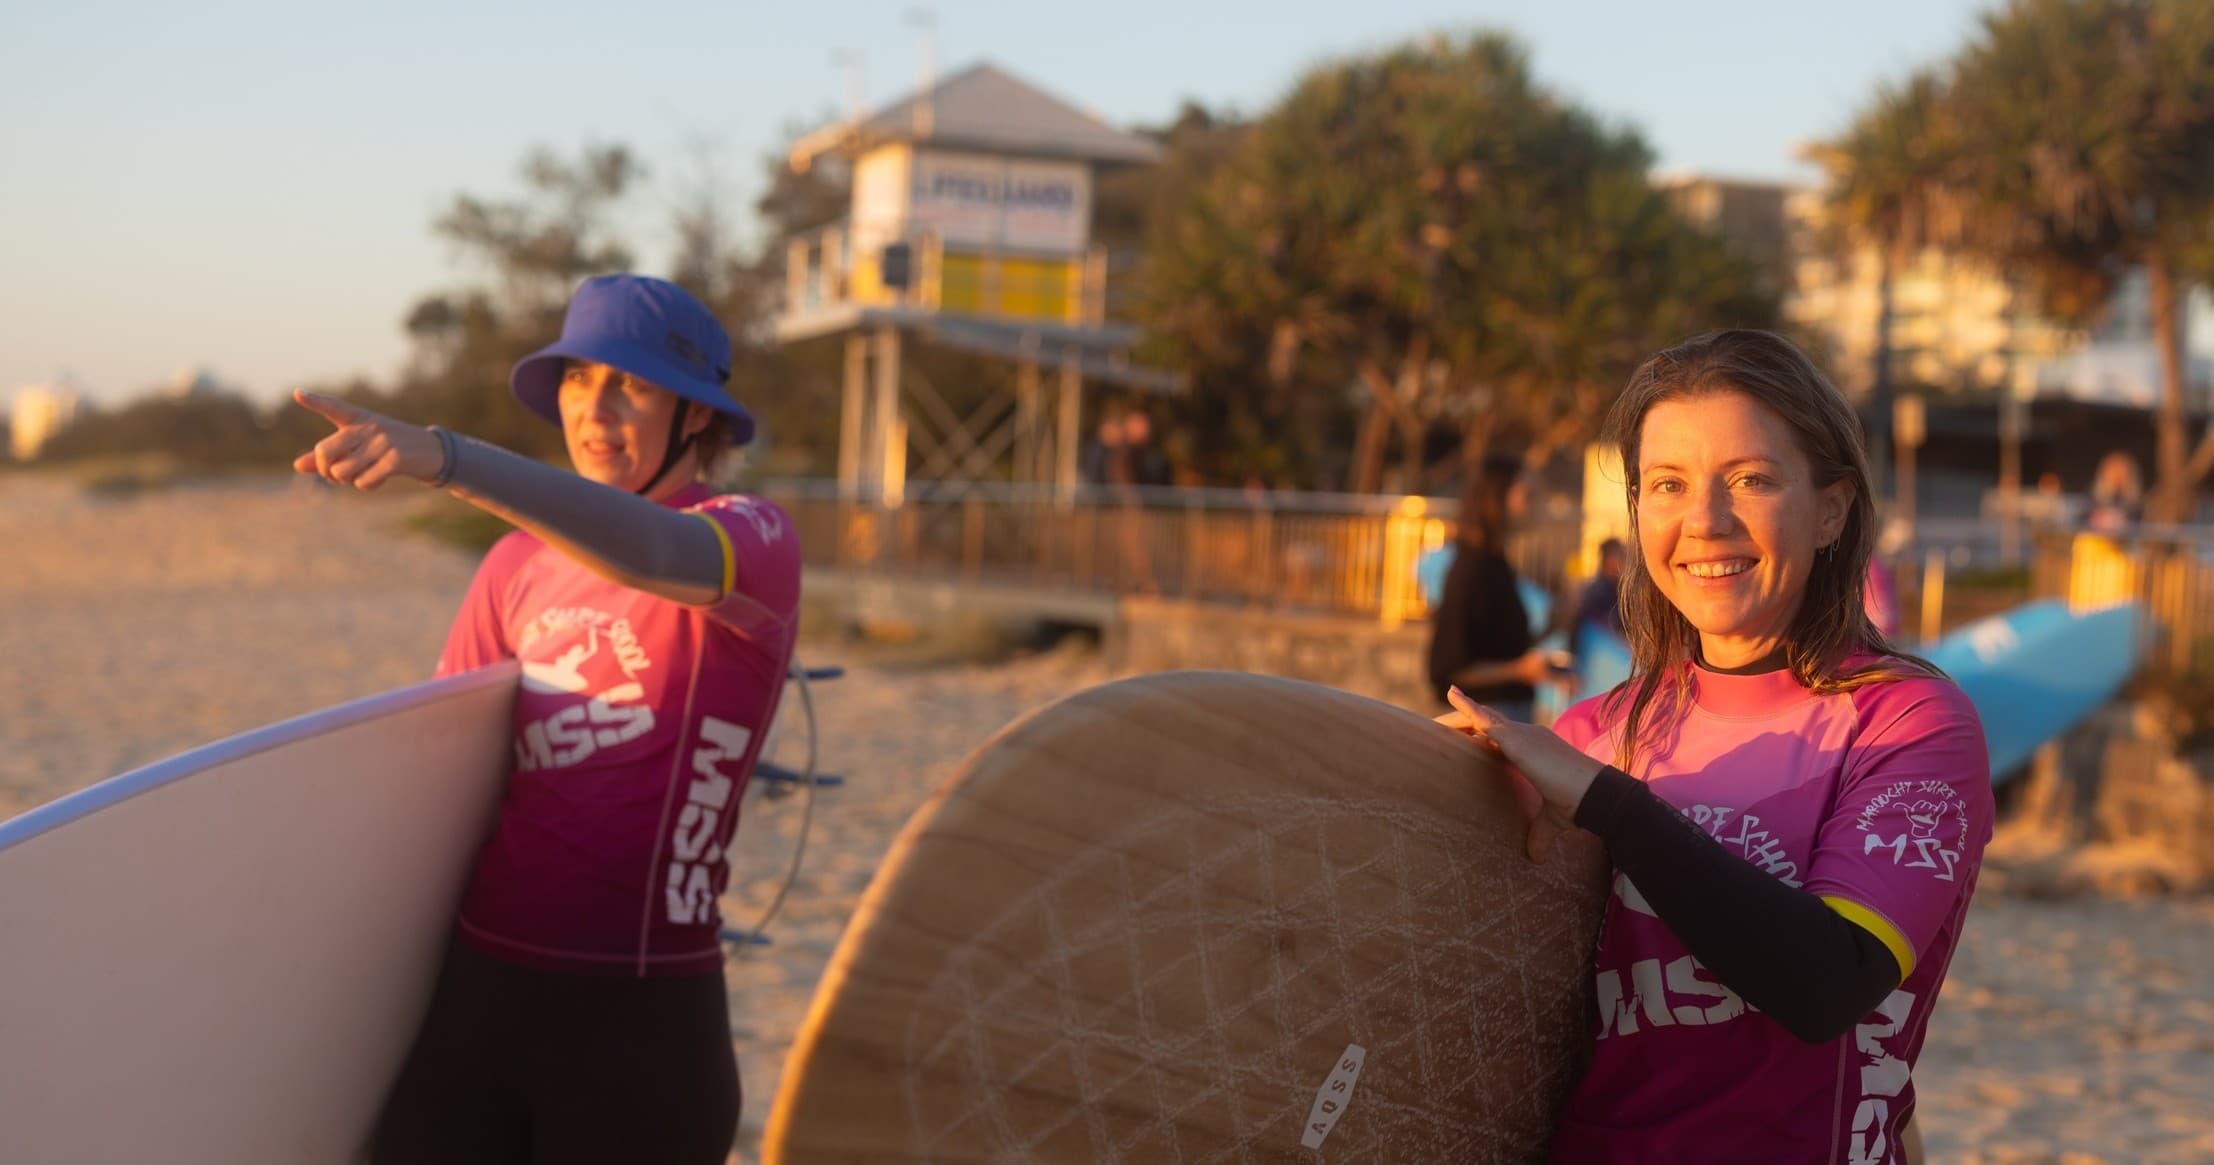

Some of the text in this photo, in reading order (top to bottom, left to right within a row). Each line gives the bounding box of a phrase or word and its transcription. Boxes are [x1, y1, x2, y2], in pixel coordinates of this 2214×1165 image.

[515, 682, 655, 771] MSS
[666, 716, 752, 924] MSS
[1856, 781, 1912, 831] MAROOCHY
[1916, 780, 1957, 799] SURF
[1864, 834, 1960, 882] MSS
[1595, 954, 1761, 1041] MS
[1312, 1059, 1356, 1135] AQSS
